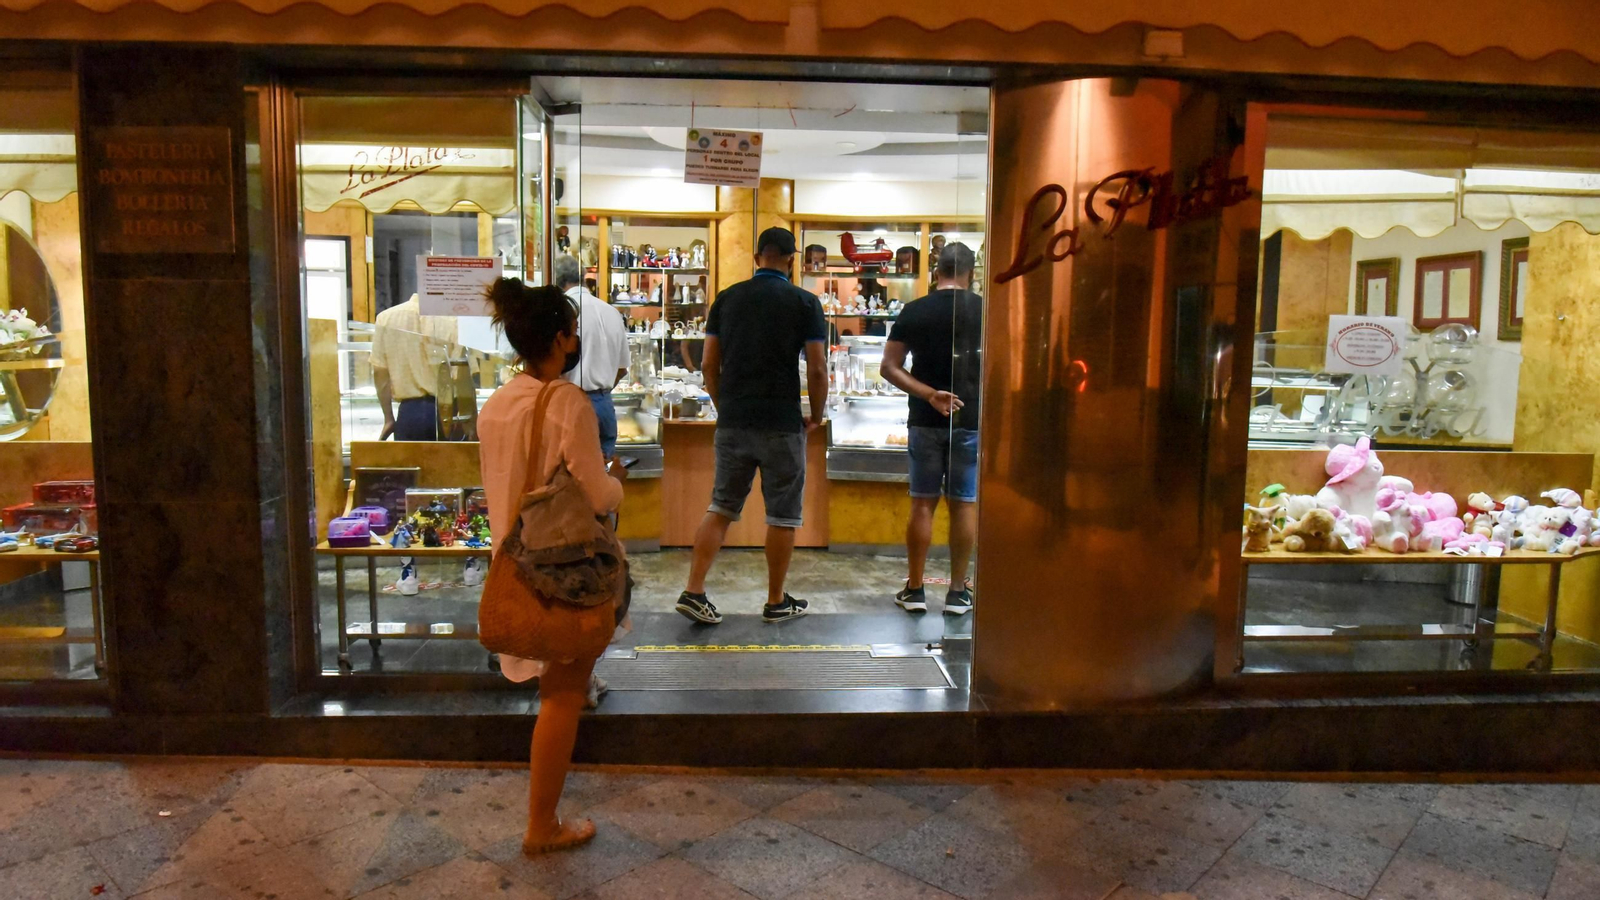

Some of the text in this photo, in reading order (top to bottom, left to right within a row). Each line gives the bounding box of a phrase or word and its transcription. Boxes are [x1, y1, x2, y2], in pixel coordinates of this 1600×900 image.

[720, 138, 728, 149] 4
[340, 146, 448, 194] La Plata
[994, 184, 1085, 284] La
